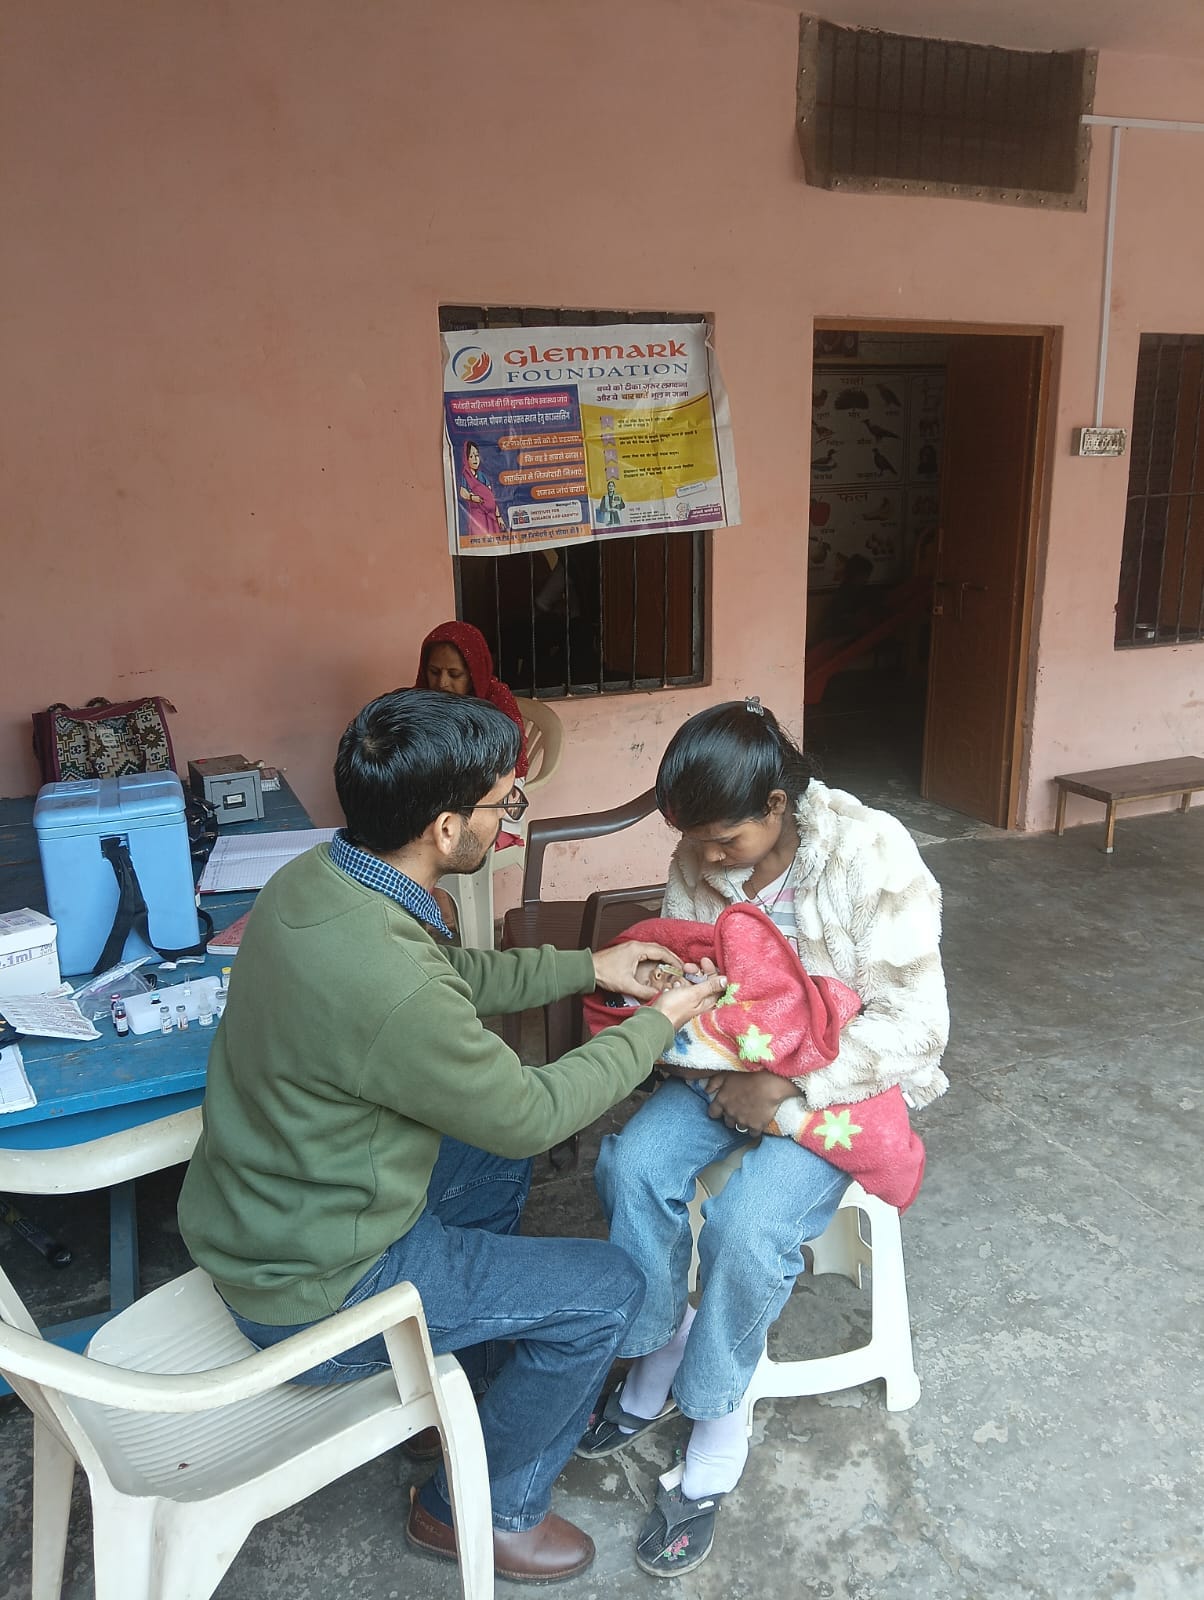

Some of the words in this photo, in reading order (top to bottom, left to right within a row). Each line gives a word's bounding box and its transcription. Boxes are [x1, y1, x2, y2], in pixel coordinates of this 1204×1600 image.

[506, 363, 688, 382] FOUNDATION
[613, 383, 622, 391] को
[625, 382, 640, 391] टीका
[596, 394, 611, 402] और
[0, 950, 32, 967] .1ml
